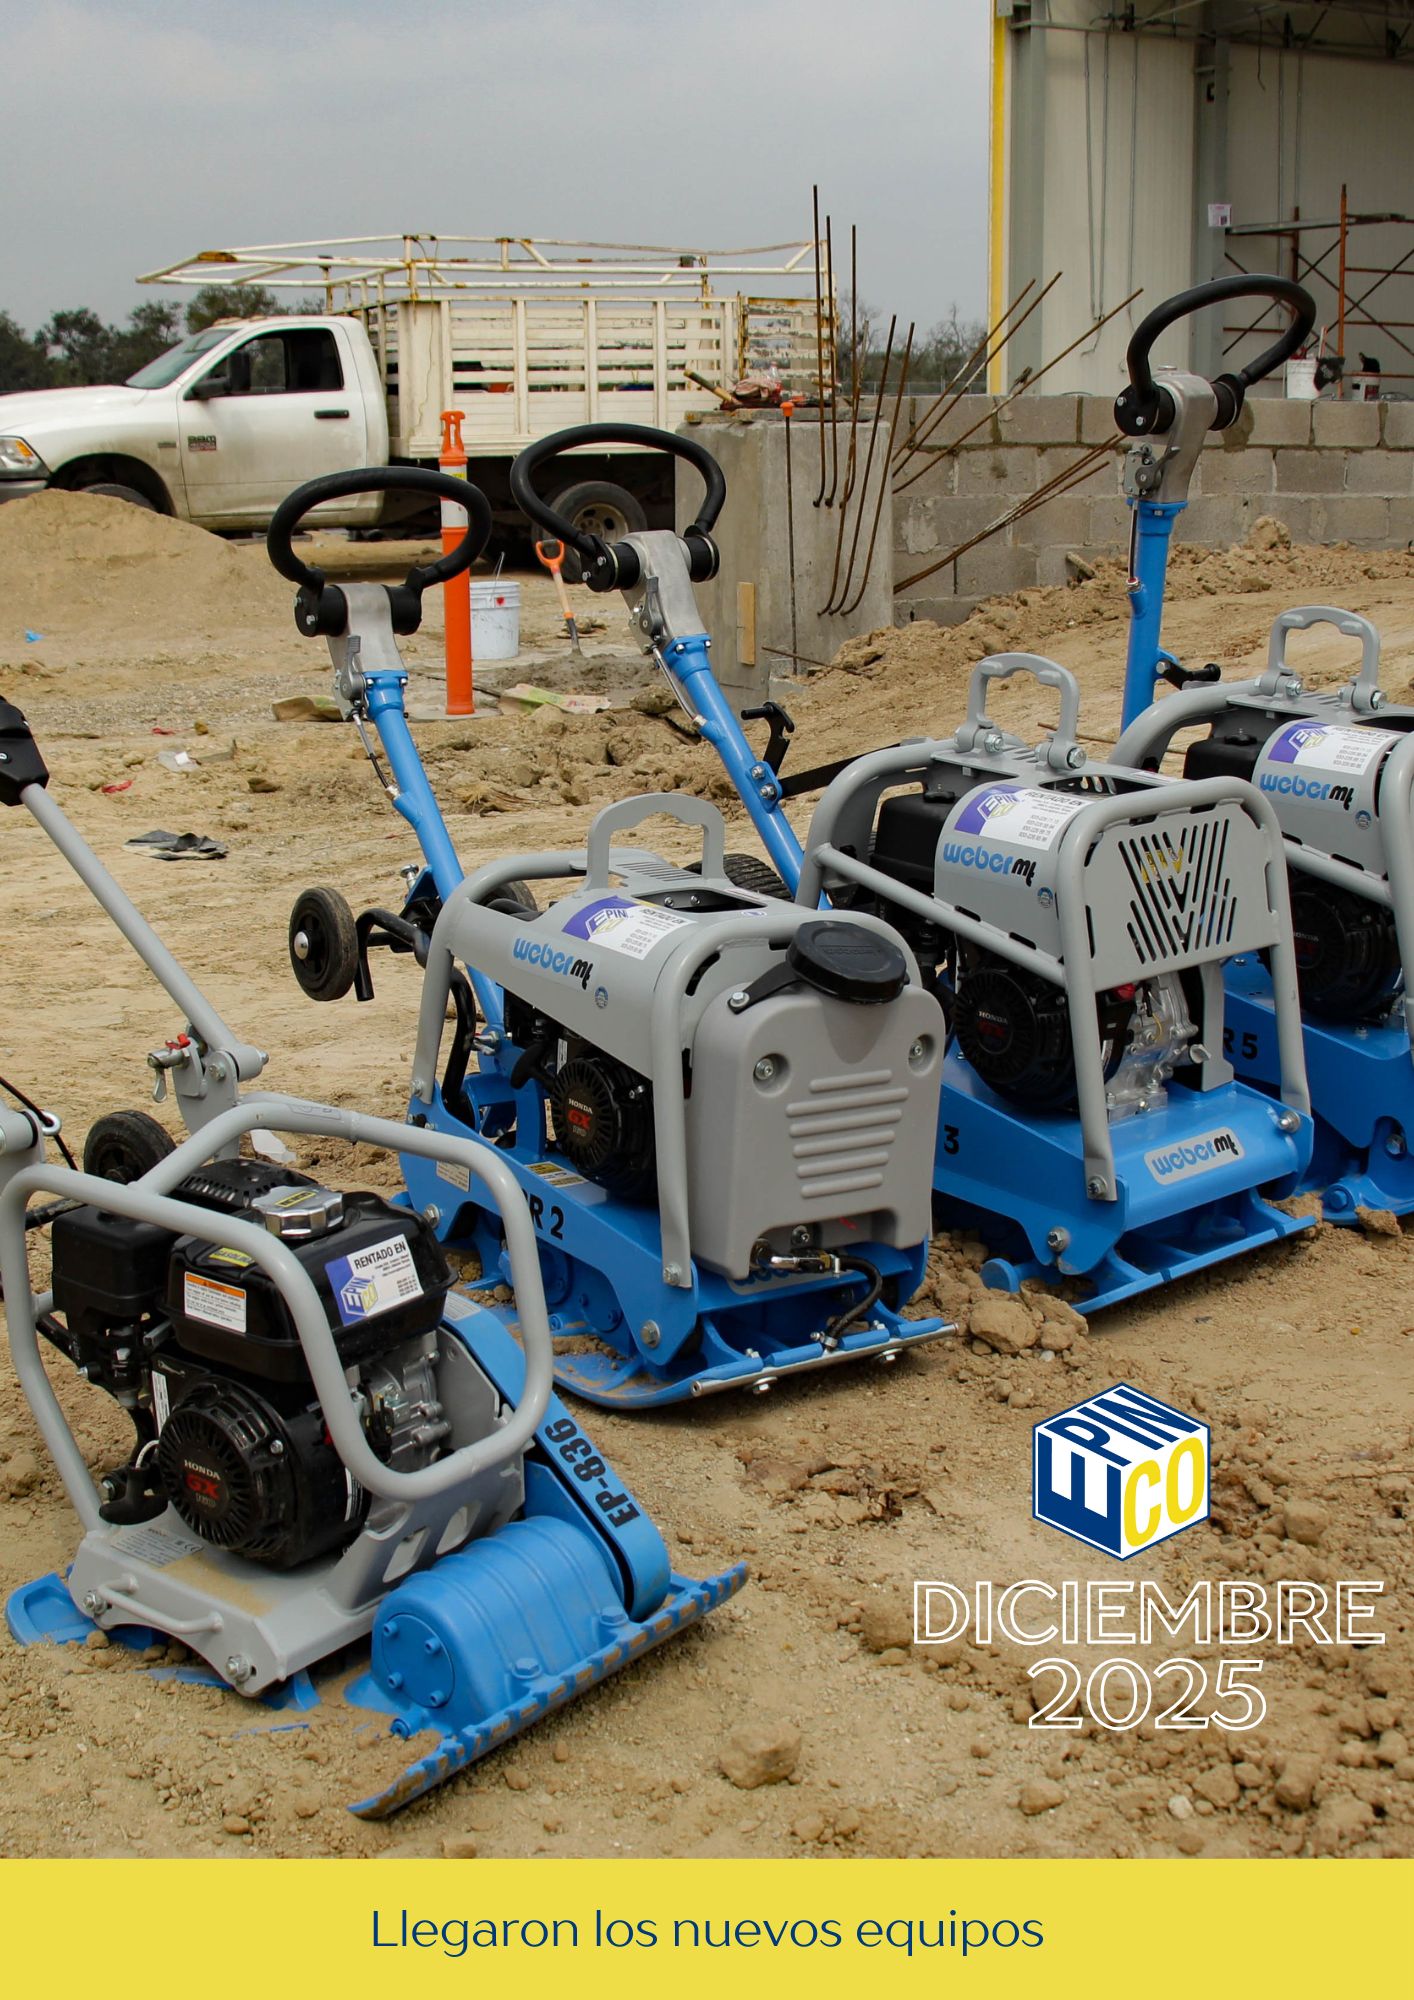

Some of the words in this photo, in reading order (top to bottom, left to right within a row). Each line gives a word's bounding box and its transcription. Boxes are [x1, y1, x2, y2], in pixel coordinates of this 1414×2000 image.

[978, 1010, 1007, 1024] HONDA
[1241, 1031, 1258, 1060] 5
[568, 1098, 593, 1115] HONDA
[568, 1109, 591, 1130] GX
[943, 1124, 960, 1155] 3
[551, 1205, 565, 1240] 2
[354, 1246, 394, 1269] RENTADO
[393, 1241, 406, 1254] EN
[184, 1459, 221, 1480] HONDA
[545, 1418, 640, 1528] EP-836
[186, 1472, 221, 1500] GX
